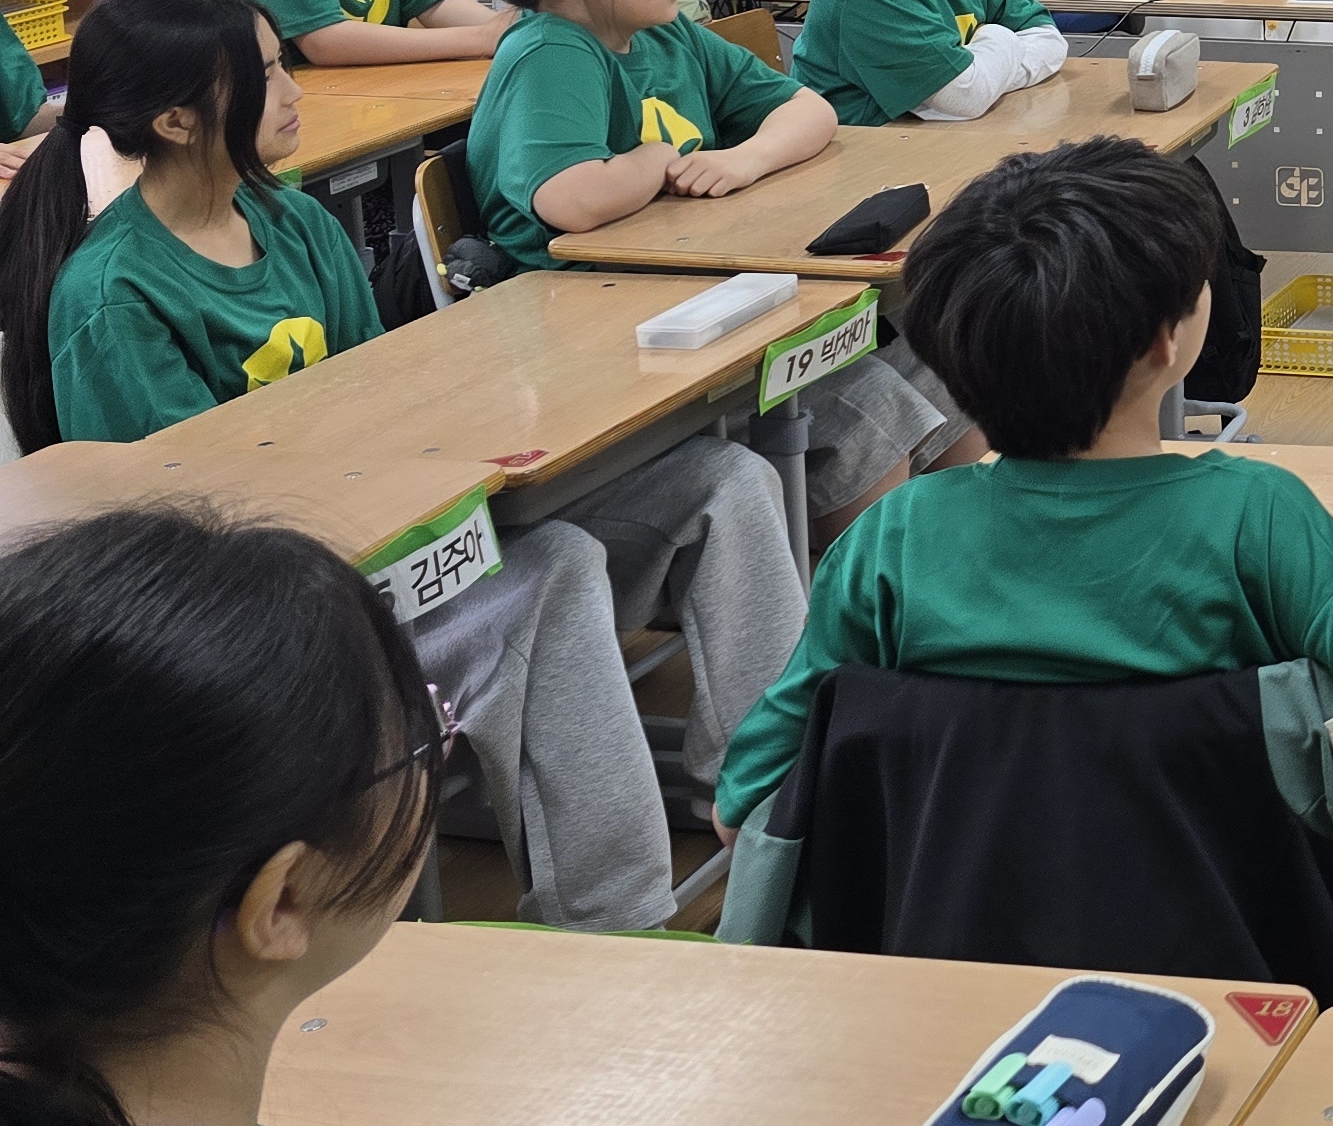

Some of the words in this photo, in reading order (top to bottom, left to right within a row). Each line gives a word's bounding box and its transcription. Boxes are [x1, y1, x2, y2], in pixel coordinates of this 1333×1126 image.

[786, 348, 814, 383] 19
[410, 519, 484, 607] 김주아
[1254, 999, 1295, 1018] 18
